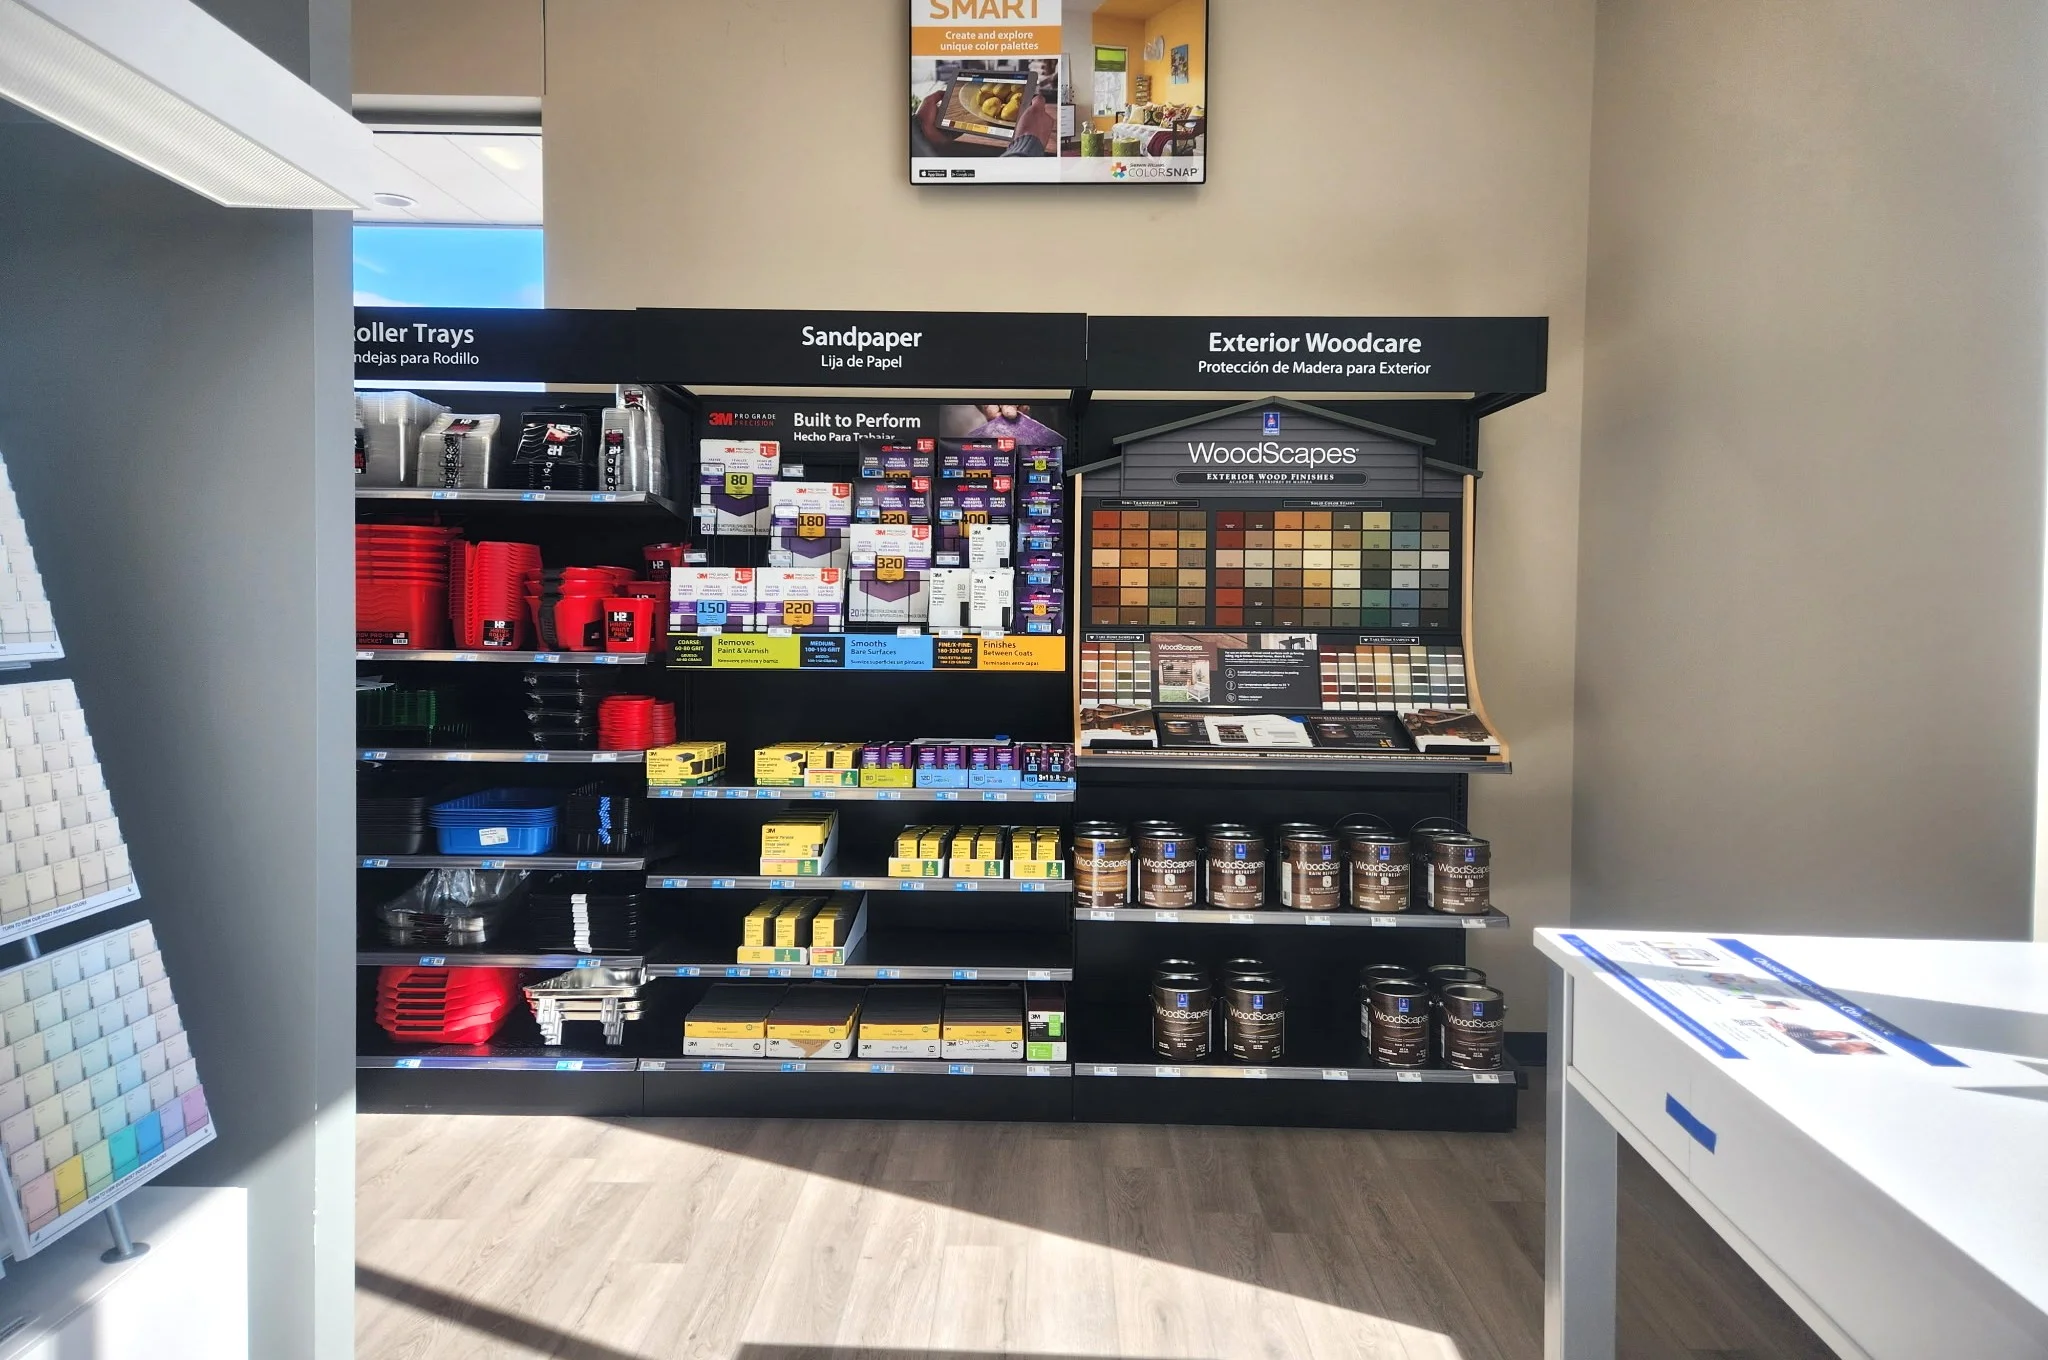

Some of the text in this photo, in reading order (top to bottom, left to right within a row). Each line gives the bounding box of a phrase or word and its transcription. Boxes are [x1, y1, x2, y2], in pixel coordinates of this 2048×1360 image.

[930, 0, 1040, 19] SMART
[945, 31, 1034, 41] Create and explore
[940, 42, 1039, 52] unique color palettes
[1128, 167, 1198, 177] COLORSNAP
[354, 321, 475, 348] oller Trays
[802, 326, 922, 351] Sandpaper
[1209, 332, 1422, 353] Exterior Woodcare
[400, 353, 430, 366] para
[433, 352, 480, 365] Rodillo
[821, 355, 902, 370] Lija de Papel
[1198, 361, 1432, 376] Protección de Madera para Exterior
[709, 412, 733, 427] 3M
[793, 413, 921, 428] Built to Perform
[793, 432, 827, 442] Hecho
[829, 432, 852, 442] Para
[1188, 442, 1358, 469] WoodScapes
[730, 474, 747, 485] 80
[1206, 473, 1335, 481] EXTERIOR WOOD FINISHES
[800, 516, 824, 526] 180
[881, 514, 905, 524] 220
[962, 514, 985, 524] 400
[878, 558, 902, 568] 320
[699, 602, 725, 613] 150
[786, 603, 811, 614] 220
[851, 609, 860, 617] 20
[851, 639, 887, 647] Smooths
[983, 640, 1016, 648] Finishes
[1158, 643, 1203, 651] WoodScapes
[1075, 856, 1128, 868] WoodScapes
[1142, 857, 1195, 869] WoodScapes
[1211, 858, 1265, 869] WoodScapes
[3, 923, 15, 931] TURN
[21, 918, 32, 926] VIEW
[41, 911, 53, 919] MOST
[53, 905, 72, 915] POPULAR
[72, 900, 87, 909] COLORS
[1156, 1006, 1210, 1020] WoodScapes
[1230, 1007, 1284, 1021] WoodScapes
